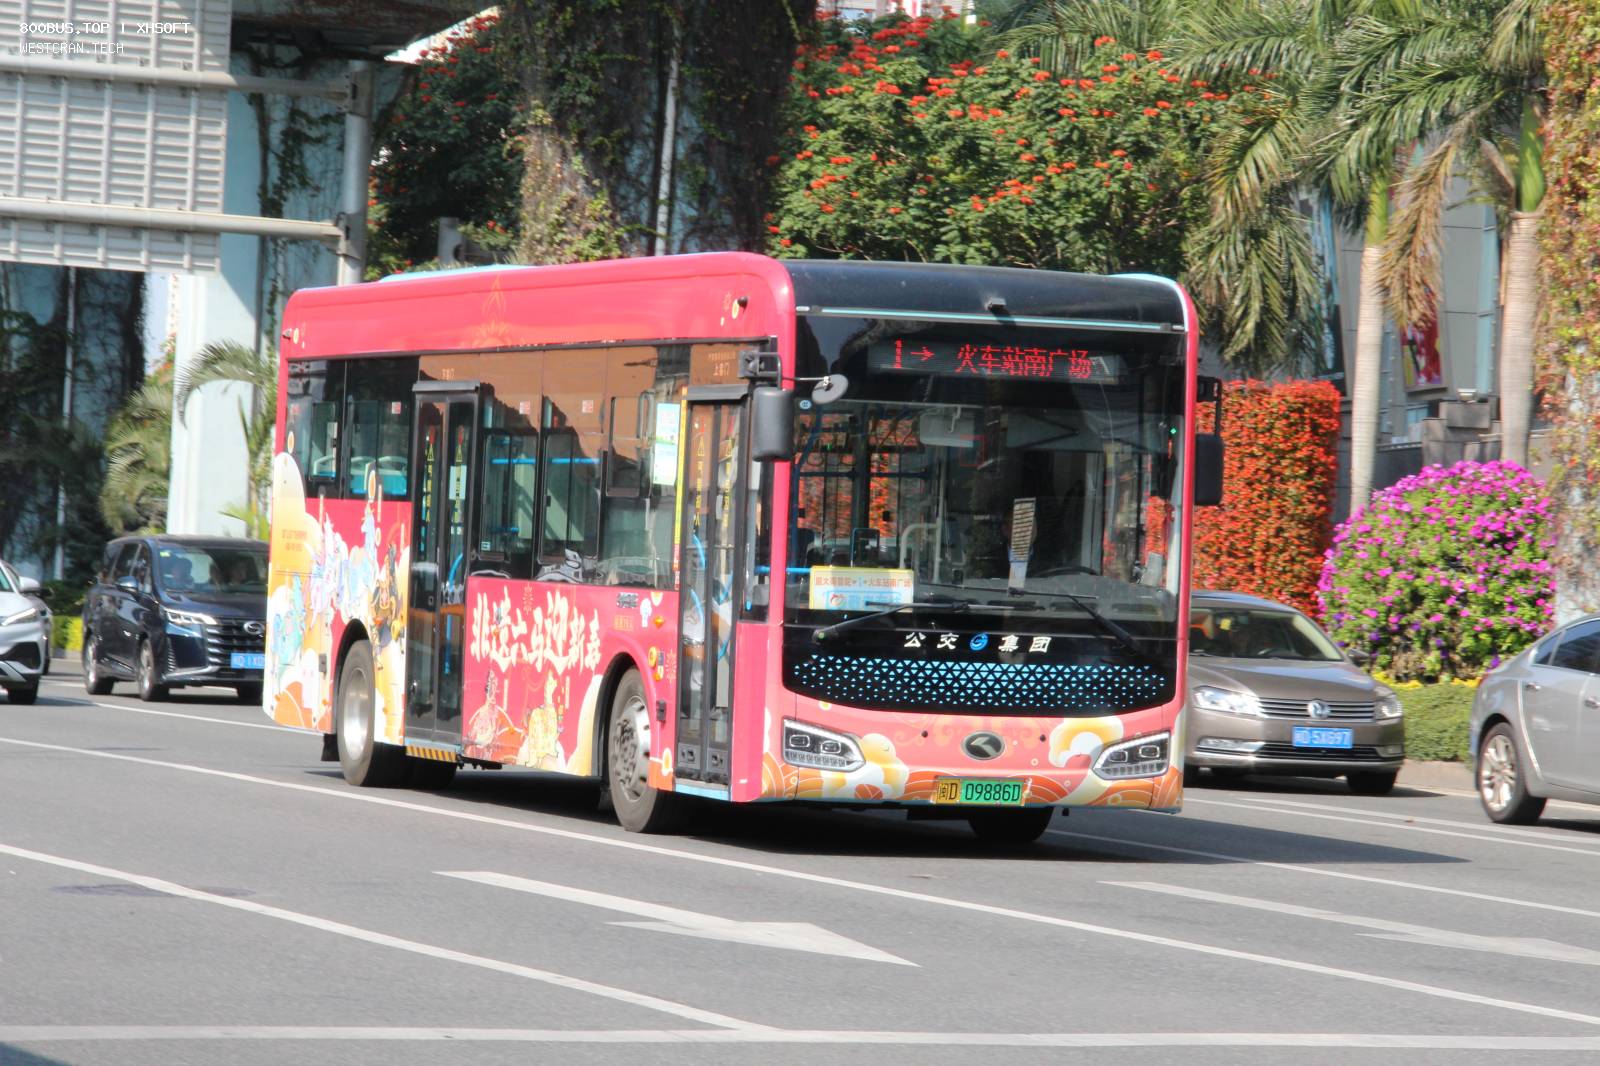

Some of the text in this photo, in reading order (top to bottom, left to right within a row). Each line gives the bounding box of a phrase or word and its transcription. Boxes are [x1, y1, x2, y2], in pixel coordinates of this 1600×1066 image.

[894, 339, 1094, 379] 1 火车站南广场
[965, 783, 1021, 802] 09886D
